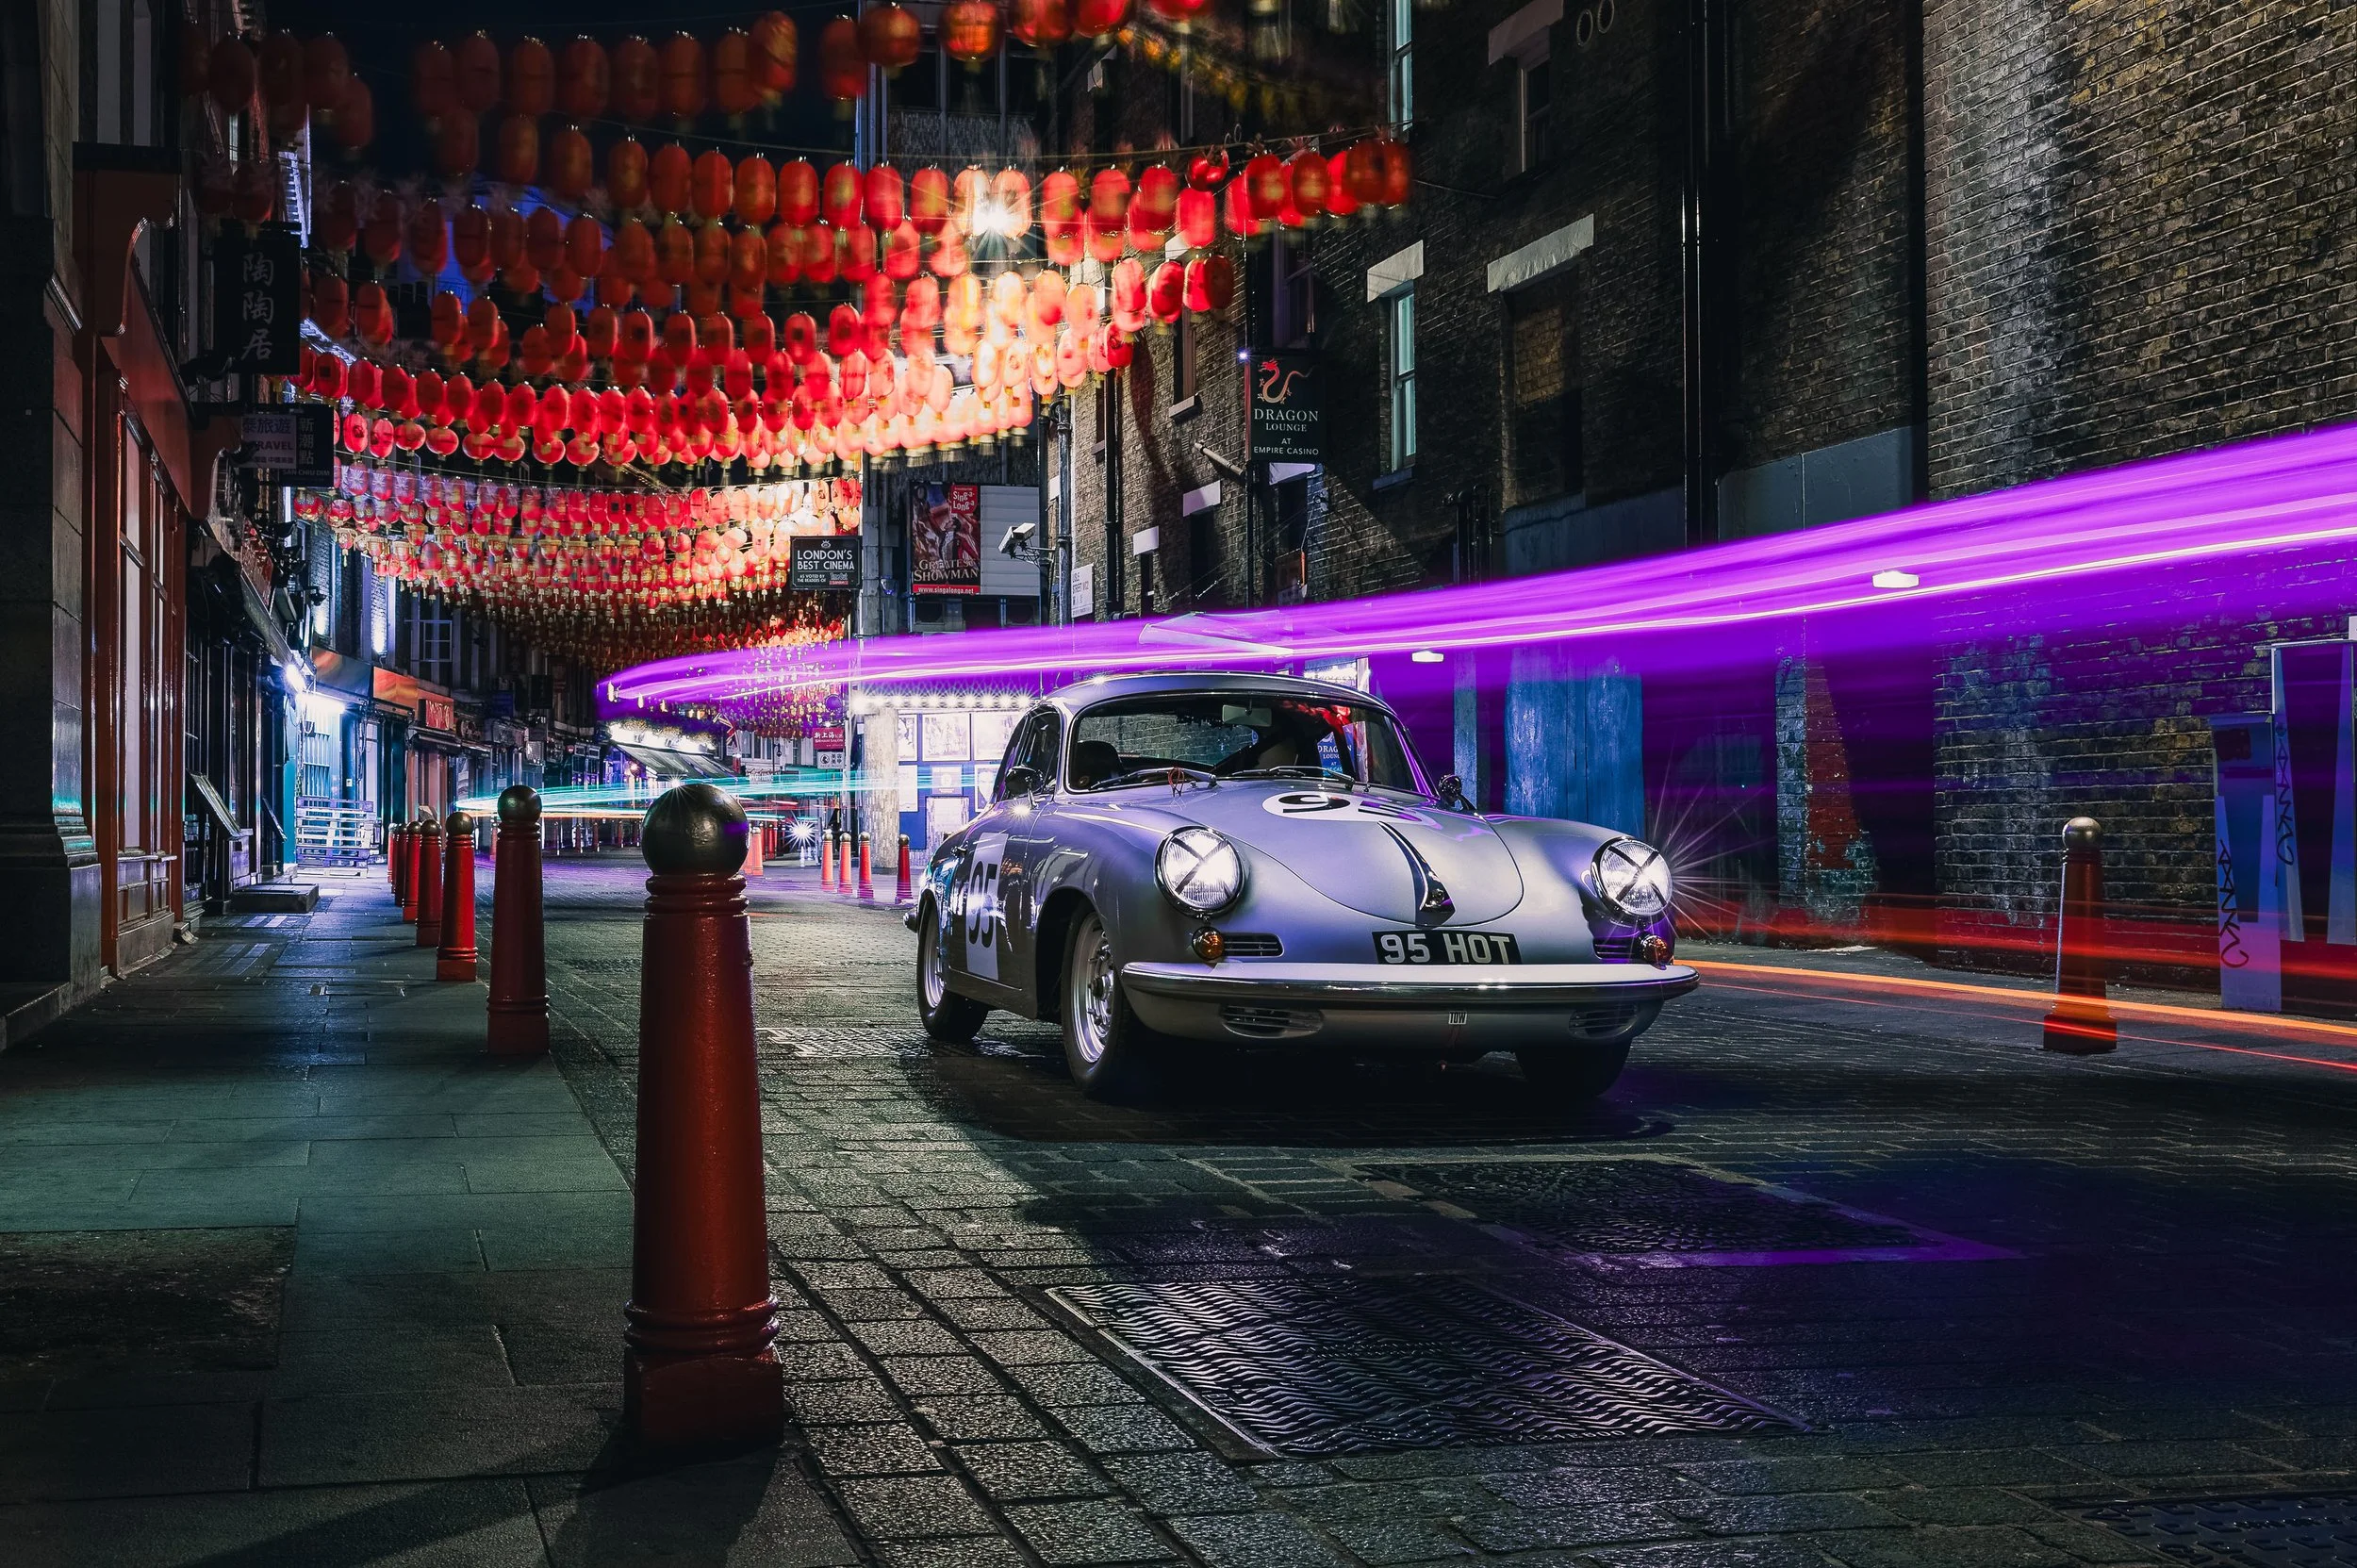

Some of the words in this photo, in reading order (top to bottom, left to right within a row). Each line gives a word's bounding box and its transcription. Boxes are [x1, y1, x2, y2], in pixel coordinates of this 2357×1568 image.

[241, 252, 273, 360] 陶陶居
[1254, 408, 1319, 421] DRAGON
[1265, 422, 1307, 432] LOUNGE
[256, 440, 294, 451] RAVEL
[1253, 446, 1283, 454] EMPIRE
[1286, 447, 1319, 455] CASINO
[797, 549, 853, 560] LONDON'S
[797, 560, 820, 570] BEST
[823, 560, 855, 570] CINEMA
[914, 569, 979, 582] SHOWMAN
[968, 860, 998, 949] 95
[1380, 933, 1430, 964] 95
[1442, 933, 1510, 965] HOT
[1449, 1012, 1467, 1024] TOW
